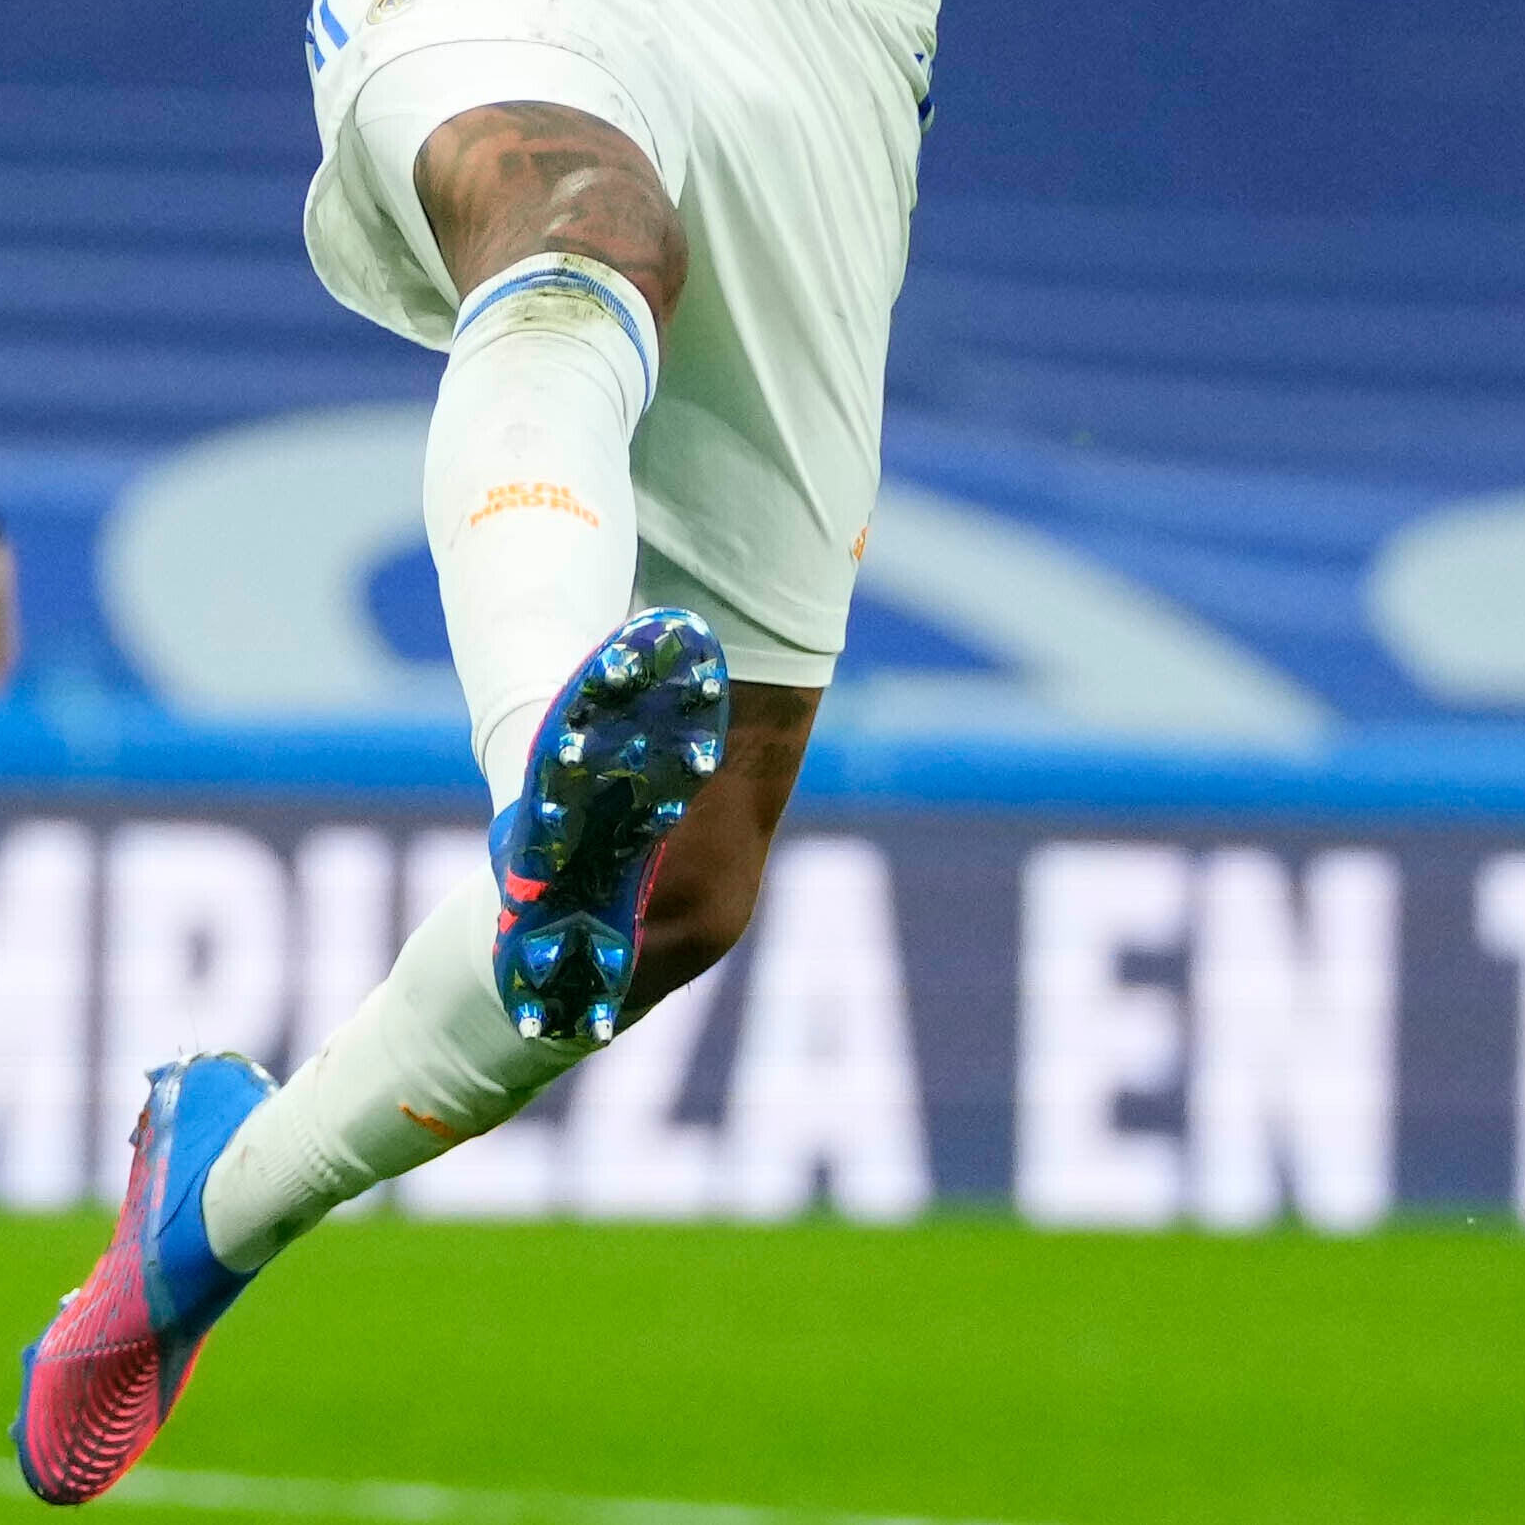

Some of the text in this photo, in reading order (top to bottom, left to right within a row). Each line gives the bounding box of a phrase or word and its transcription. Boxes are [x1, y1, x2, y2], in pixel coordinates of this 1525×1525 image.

[486, 481, 572, 502] REAL
[469, 493, 600, 529] MADRID
[1013, 841, 1401, 1233] EN
